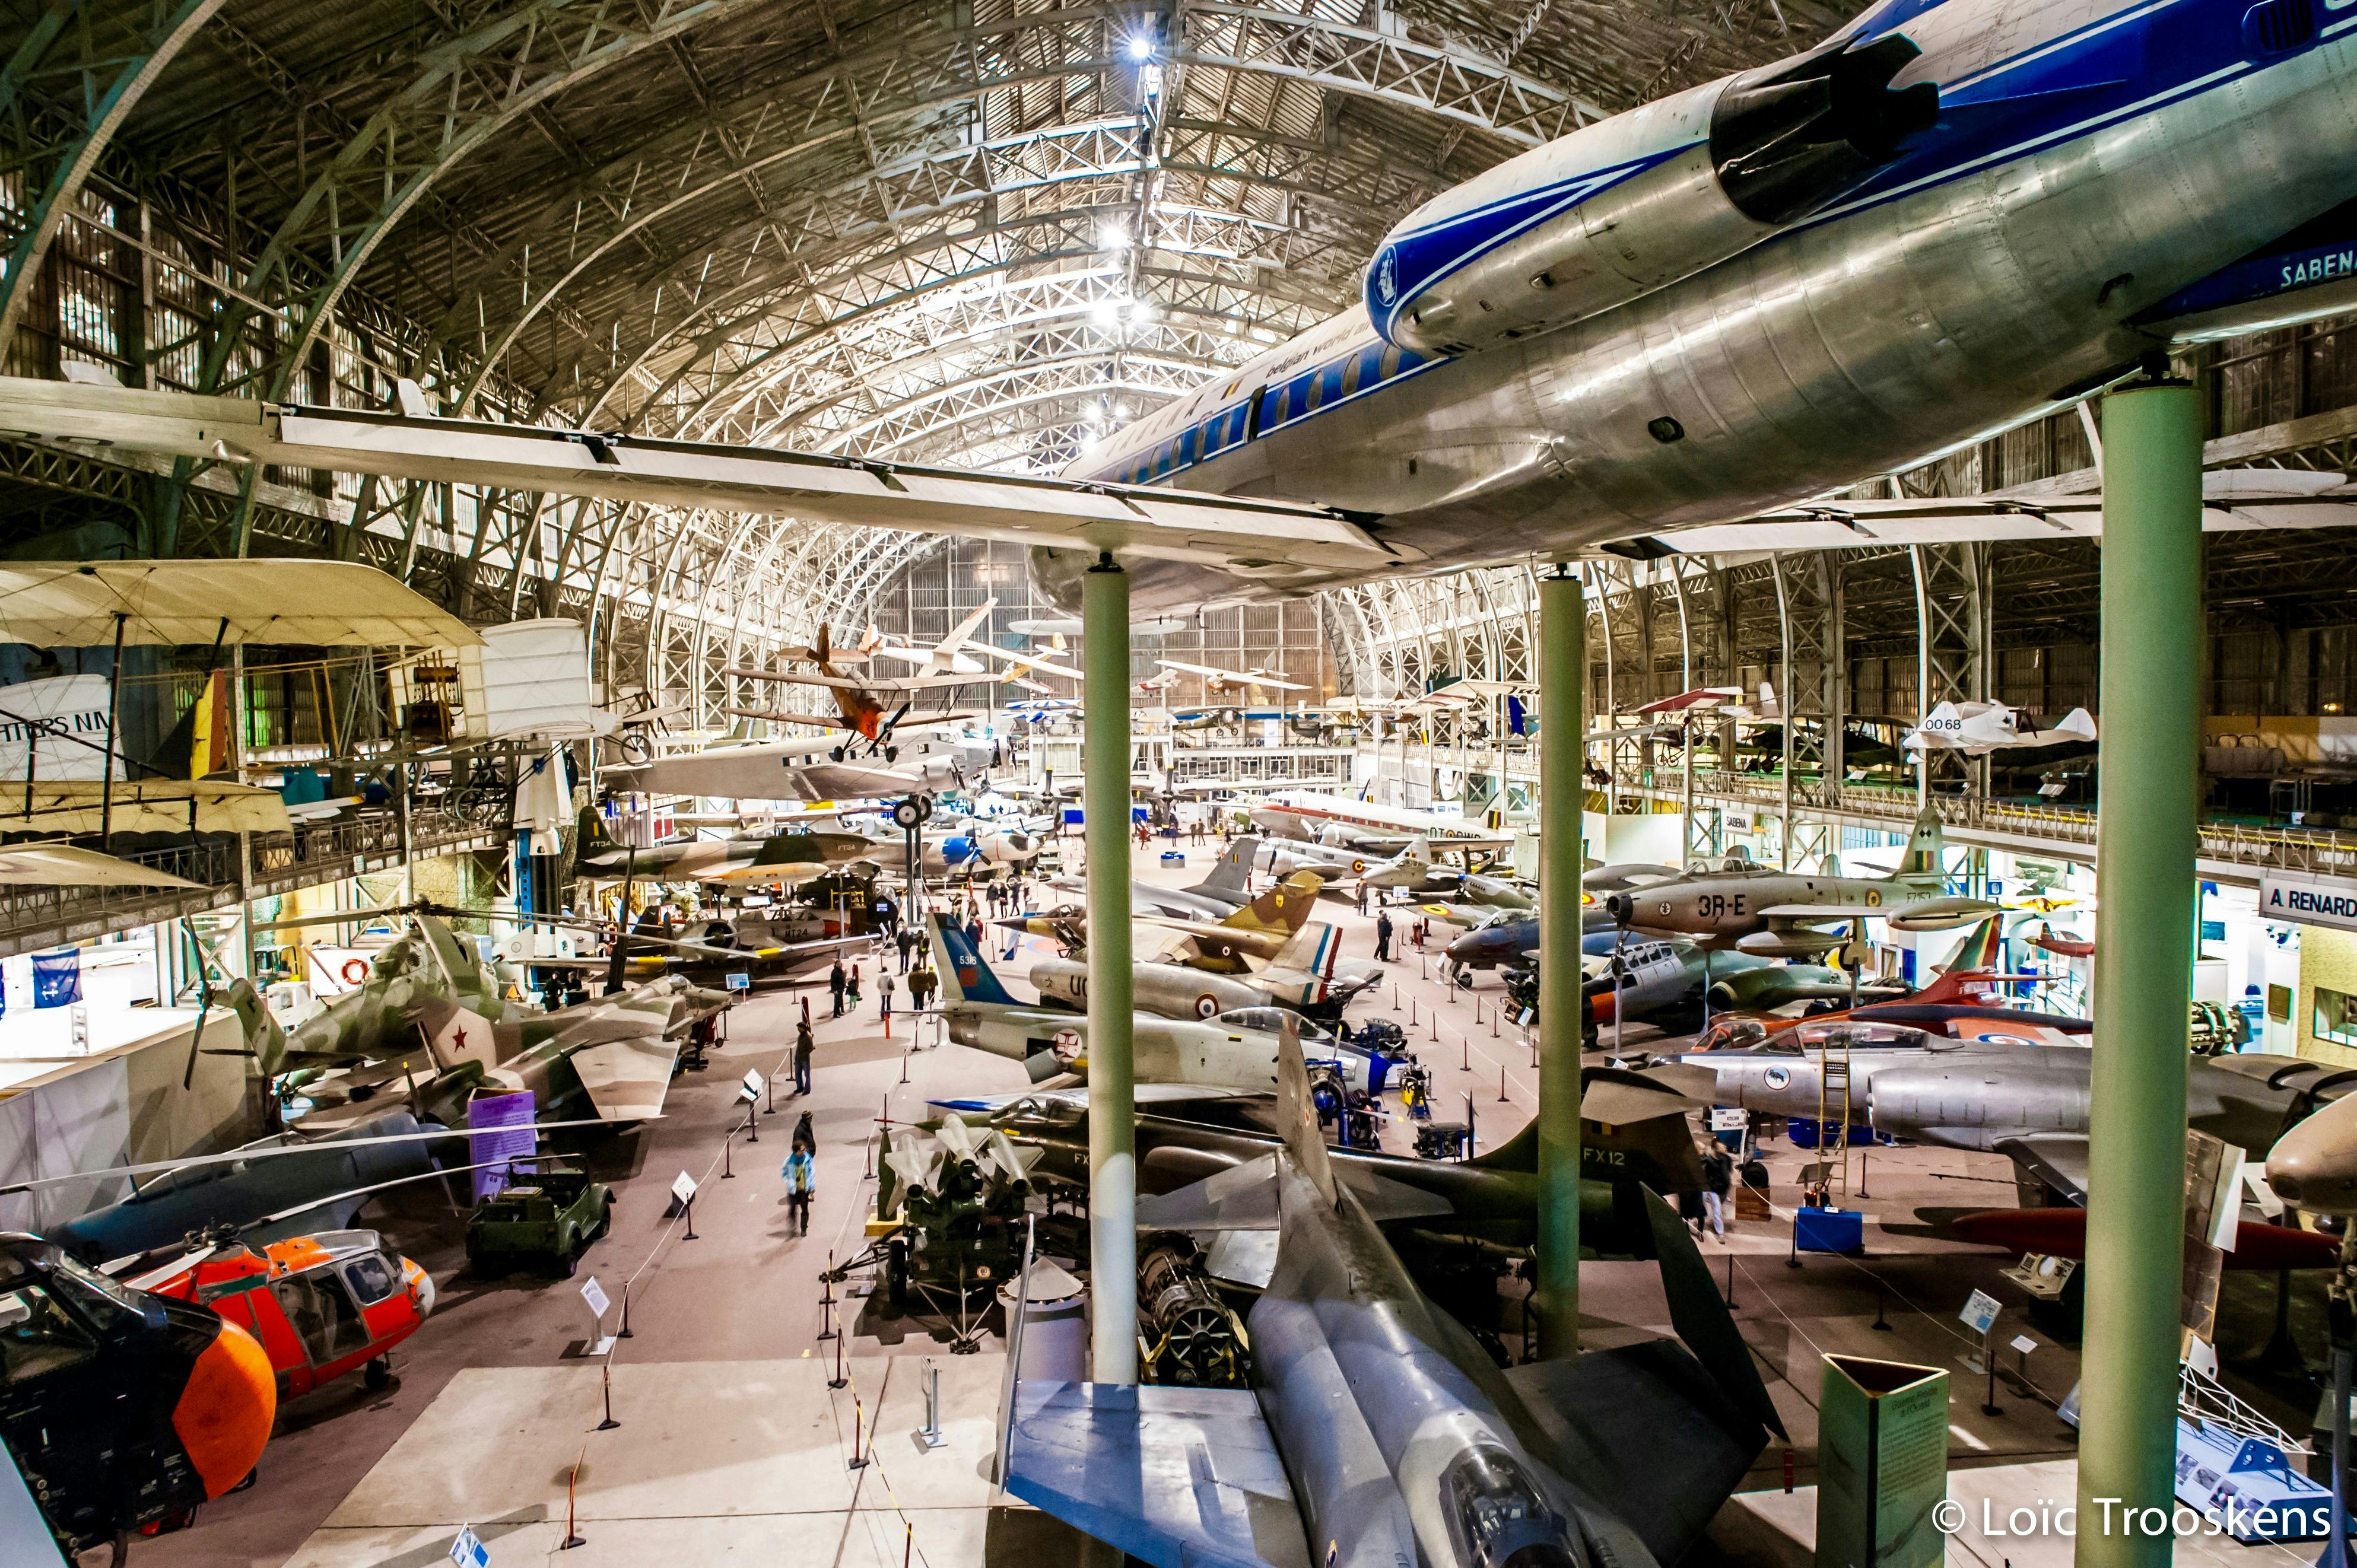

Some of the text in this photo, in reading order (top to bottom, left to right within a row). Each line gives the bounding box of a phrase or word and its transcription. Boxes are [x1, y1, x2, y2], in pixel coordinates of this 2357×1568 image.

[2280, 249, 2357, 288] SABEN
[1266, 350, 1310, 379] belgian
[1313, 323, 1355, 355] world
[1698, 894, 1746, 917] 3R-E
[2289, 890, 2357, 917] RENARD
[1584, 1147, 1625, 1166] FX12
